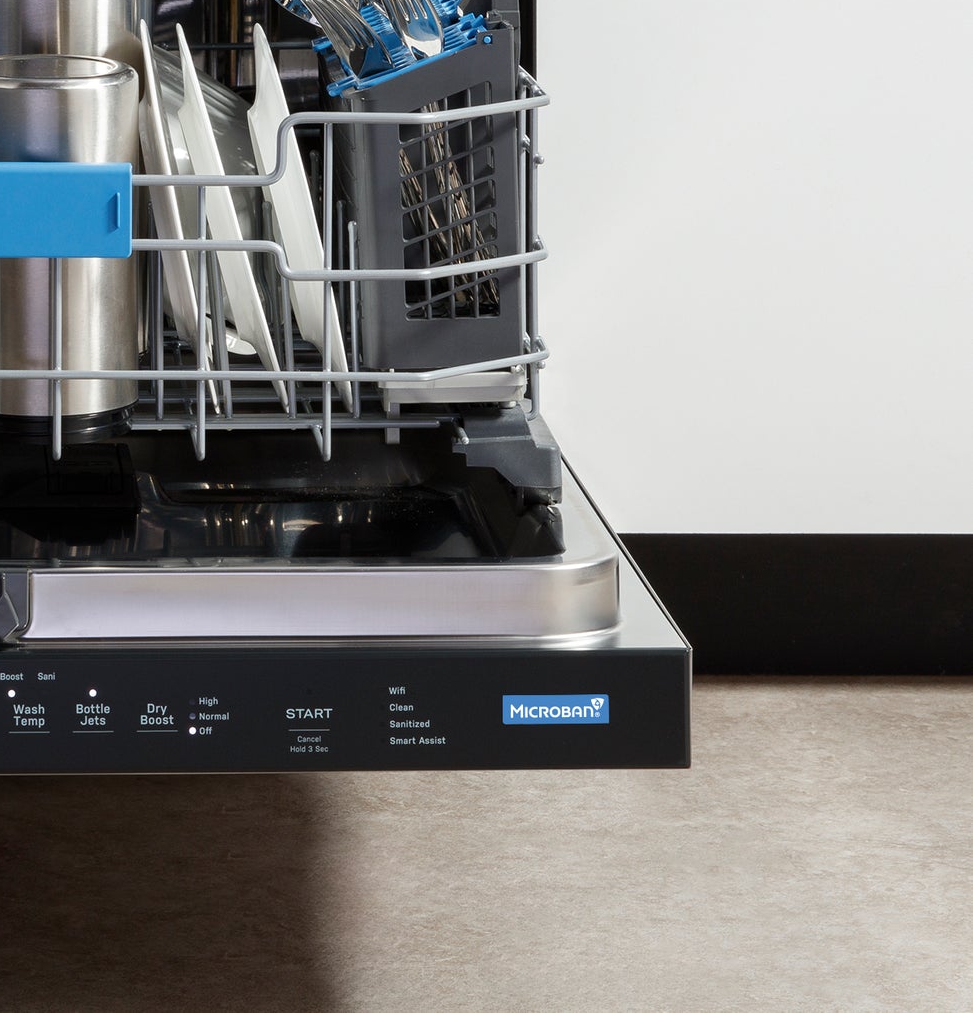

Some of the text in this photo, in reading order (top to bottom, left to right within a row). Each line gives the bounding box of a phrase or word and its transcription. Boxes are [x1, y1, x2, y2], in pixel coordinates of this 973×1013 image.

[0, 672, 23, 681] Boost
[38, 672, 55, 680] Sani
[389, 686, 405, 695] Wifi
[199, 697, 218, 706] High
[13, 704, 44, 714] Wash
[76, 704, 110, 714] Bottle
[148, 704, 167, 715] Dry
[390, 703, 413, 712] Clean
[199, 712, 229, 721] Normal
[286, 709, 333, 719] START
[14, 716, 45, 728] Temp
[80, 716, 106, 725] Jets
[141, 715, 174, 725] Boost
[390, 720, 430, 728] Sanitized
[199, 727, 212, 735] Off
[297, 735, 321, 743] Cancel
[390, 736, 445, 745] Smart Assist
[290, 745, 306, 753] Hold
[315, 745, 328, 753] Sec
